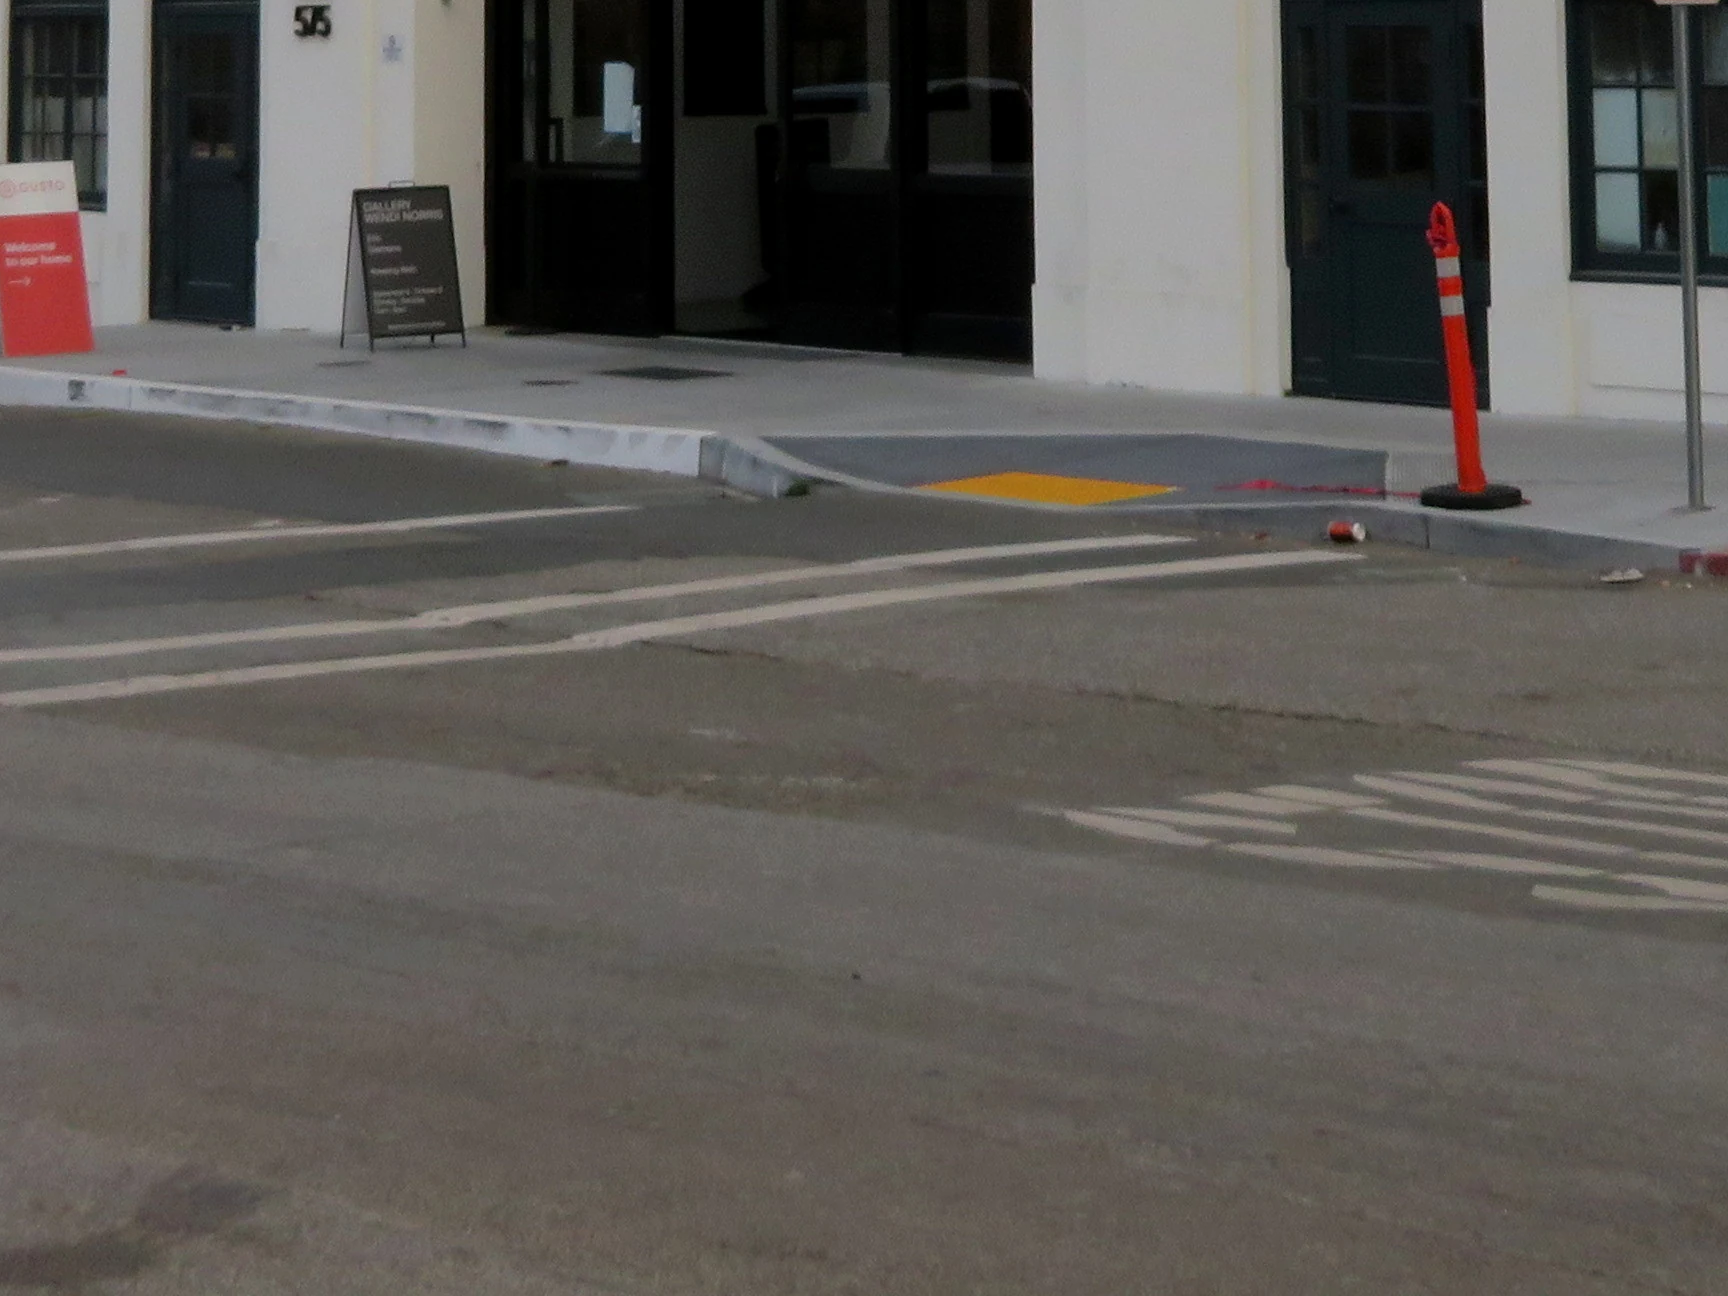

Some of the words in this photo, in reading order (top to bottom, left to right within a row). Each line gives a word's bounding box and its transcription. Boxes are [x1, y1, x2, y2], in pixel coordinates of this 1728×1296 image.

[19, 179, 65, 193] GUSTO
[4, 241, 56, 253] Welcome
[40, 254, 73, 264] home
